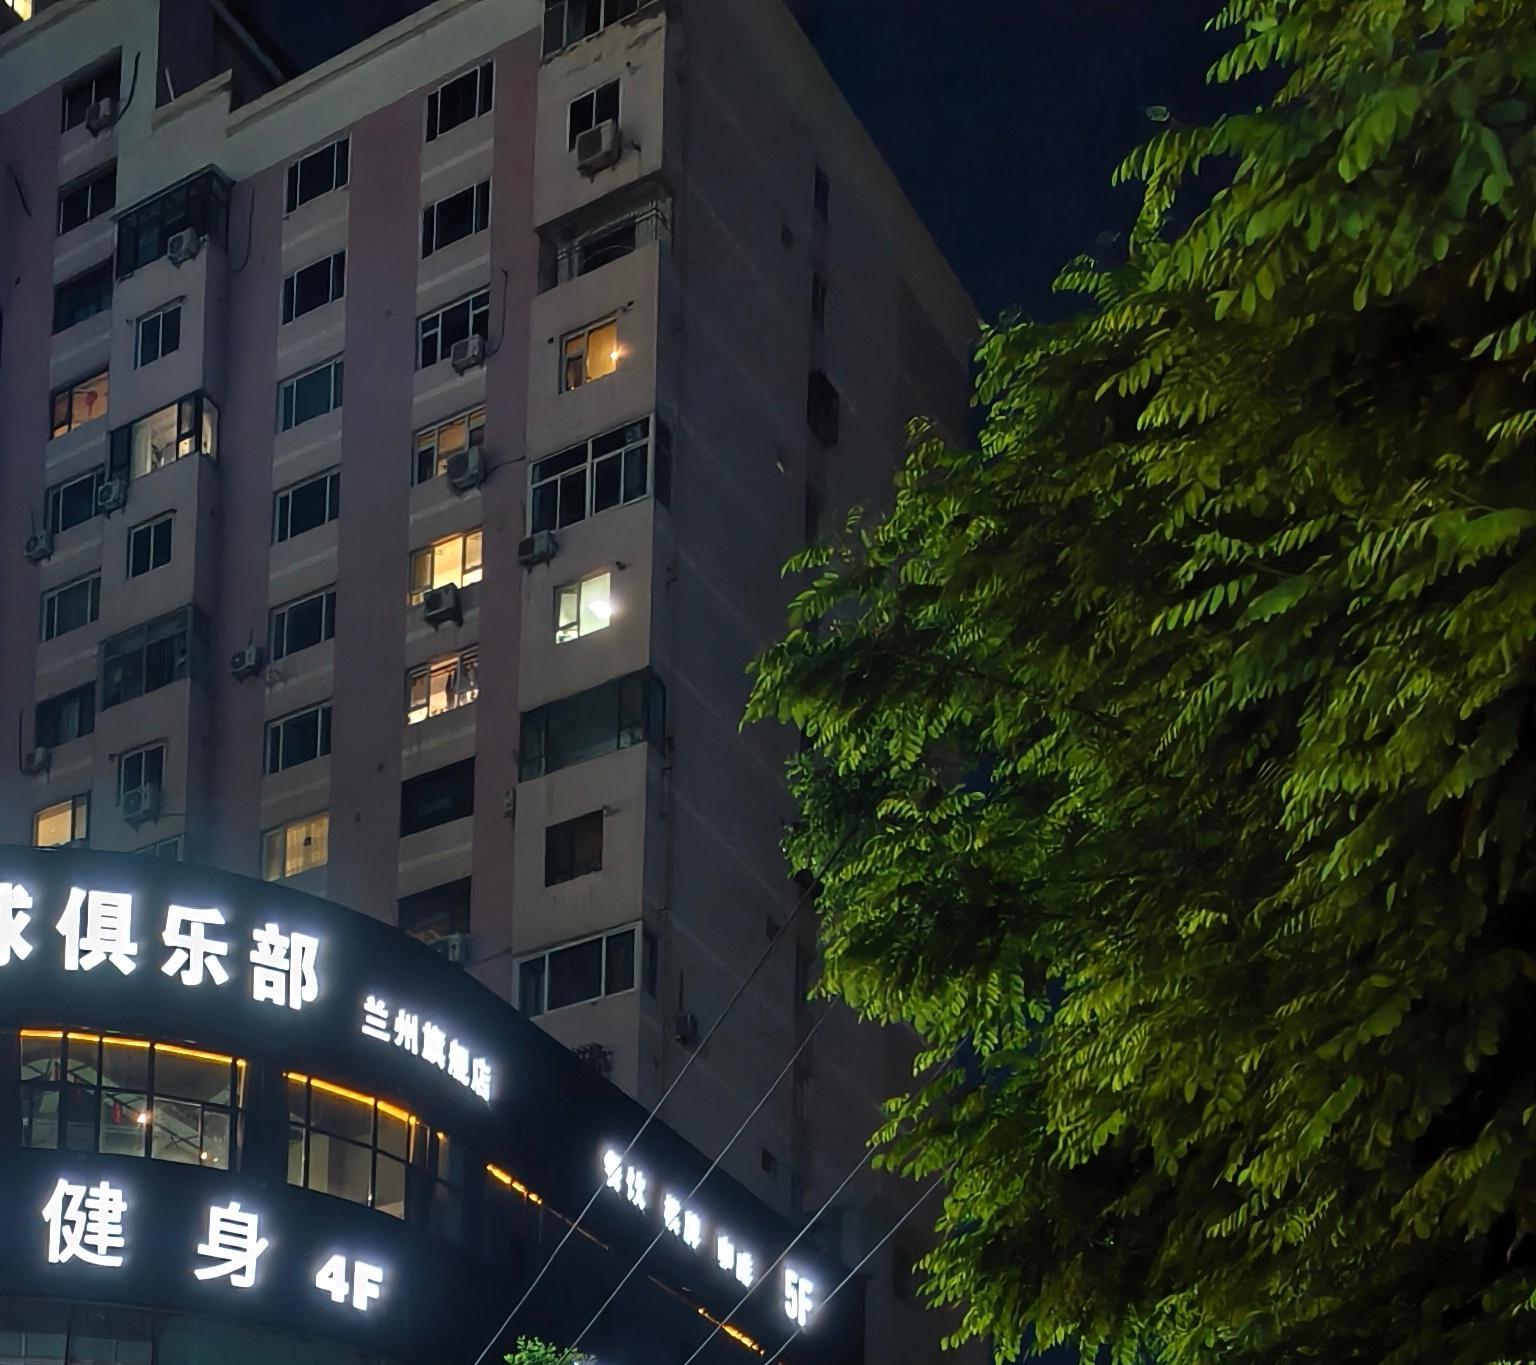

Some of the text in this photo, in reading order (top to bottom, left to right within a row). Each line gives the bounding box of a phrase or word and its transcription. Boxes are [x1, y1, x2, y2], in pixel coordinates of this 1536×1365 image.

[362, 995, 492, 1102] 兰州旗舰店
[314, 1253, 385, 1312] 4F
[784, 1268, 814, 1327] 5F
